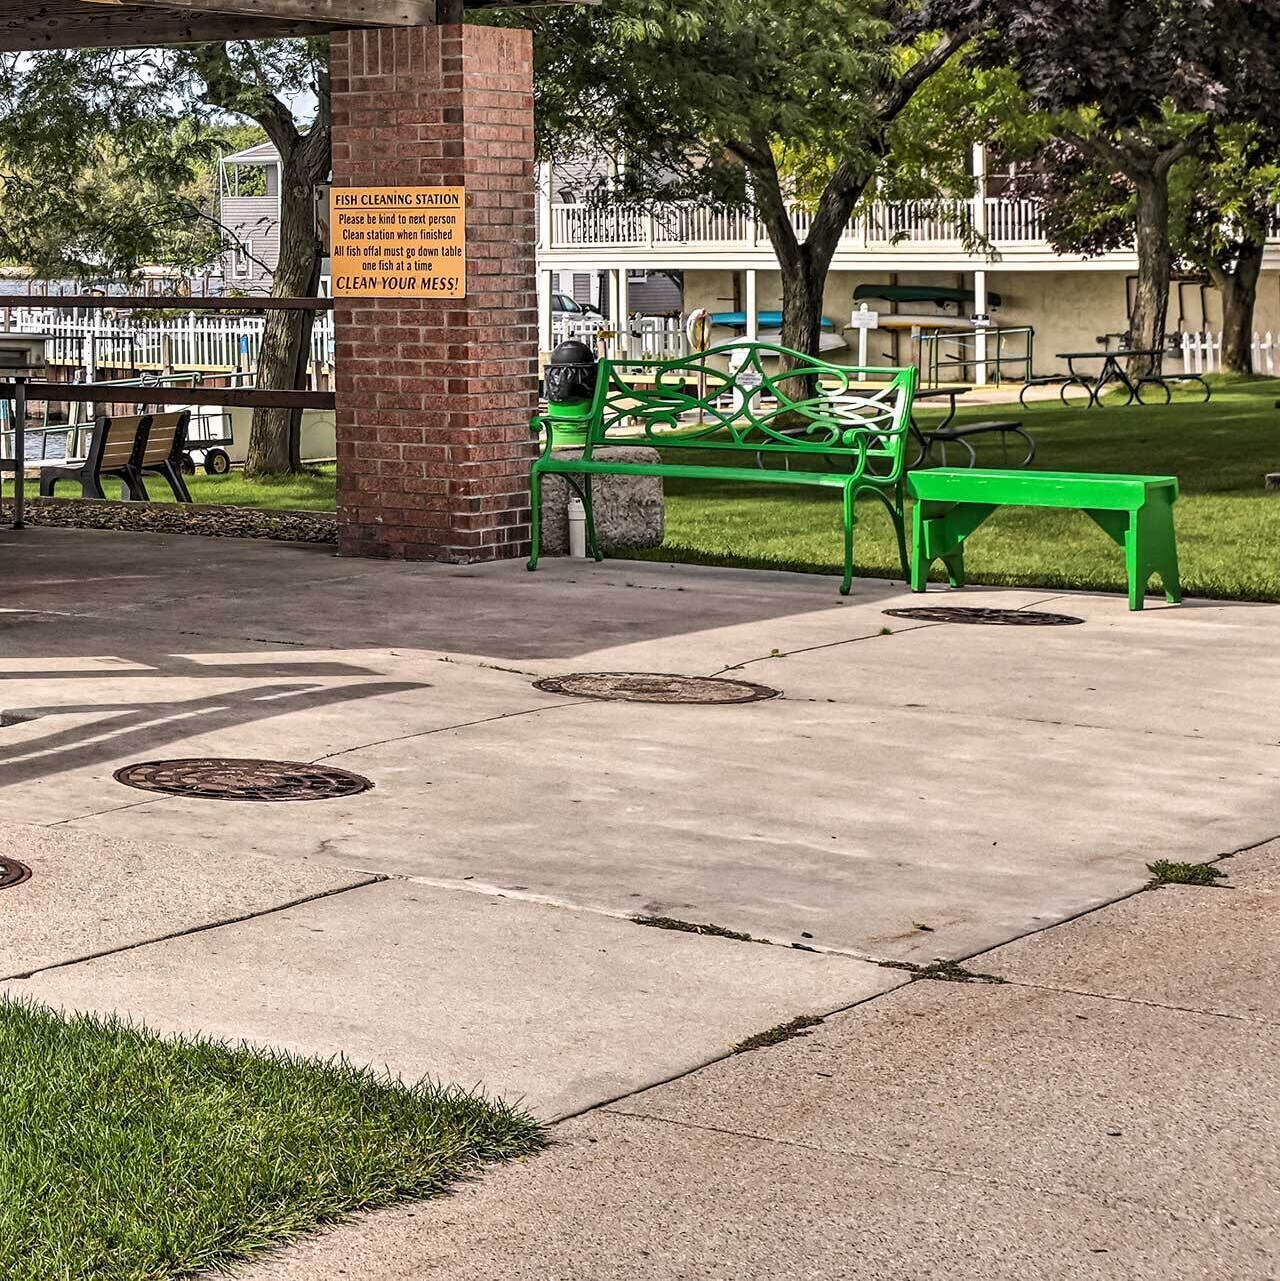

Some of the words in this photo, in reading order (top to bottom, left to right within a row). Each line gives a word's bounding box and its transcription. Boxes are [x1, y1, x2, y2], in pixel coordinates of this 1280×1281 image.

[336, 195, 357, 205] FISH
[361, 194, 412, 205] CLEANING
[416, 194, 459, 204] STATION
[339, 214, 364, 224] Please
[367, 214, 376, 224] be
[379, 214, 395, 224] kind
[398, 215, 406, 224] to
[409, 215, 425, 224] next
[428, 215, 456, 225] person
[343, 229, 364, 239] Clean
[367, 230, 394, 239] station
[397, 230, 417, 239] when
[420, 230, 452, 239] finished
[334, 246, 344, 256] All
[346, 246, 360, 256] fish
[364, 246, 381, 256] offal
[384, 248, 403, 256] must
[406, 249, 415, 258] go
[418, 247, 438, 256] down
[442, 247, 462, 256] table
[379, 261, 393, 270] fish
[396, 262, 404, 270] at
[414, 261, 432, 270] time
[336, 277, 377, 290] CLEAN
[382, 277, 416, 290] YOUR
[420, 277, 459, 290] MESS!
